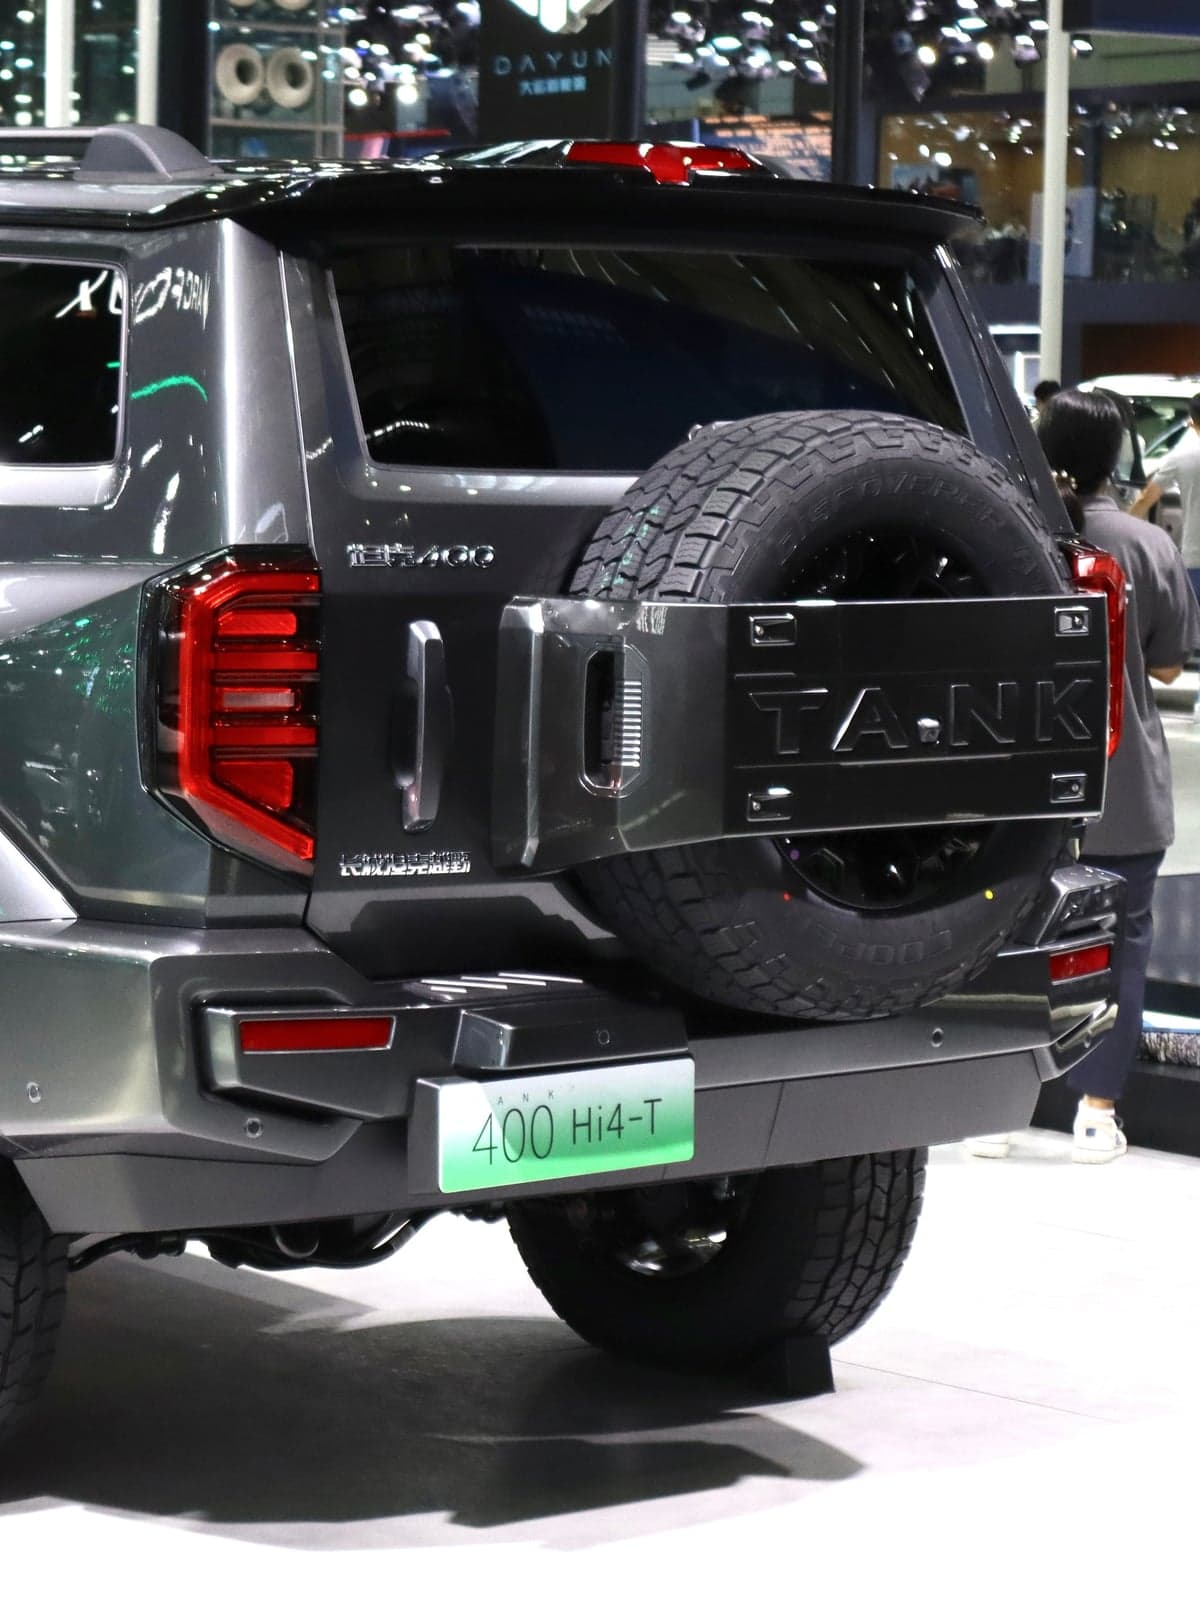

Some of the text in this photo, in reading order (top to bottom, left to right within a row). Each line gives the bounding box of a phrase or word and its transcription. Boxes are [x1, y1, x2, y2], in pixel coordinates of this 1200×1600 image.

[494, 48, 612, 76] DAYUN
[749, 679, 1094, 754] TANK
[471, 1098, 662, 1165] 400 Hi4-T
